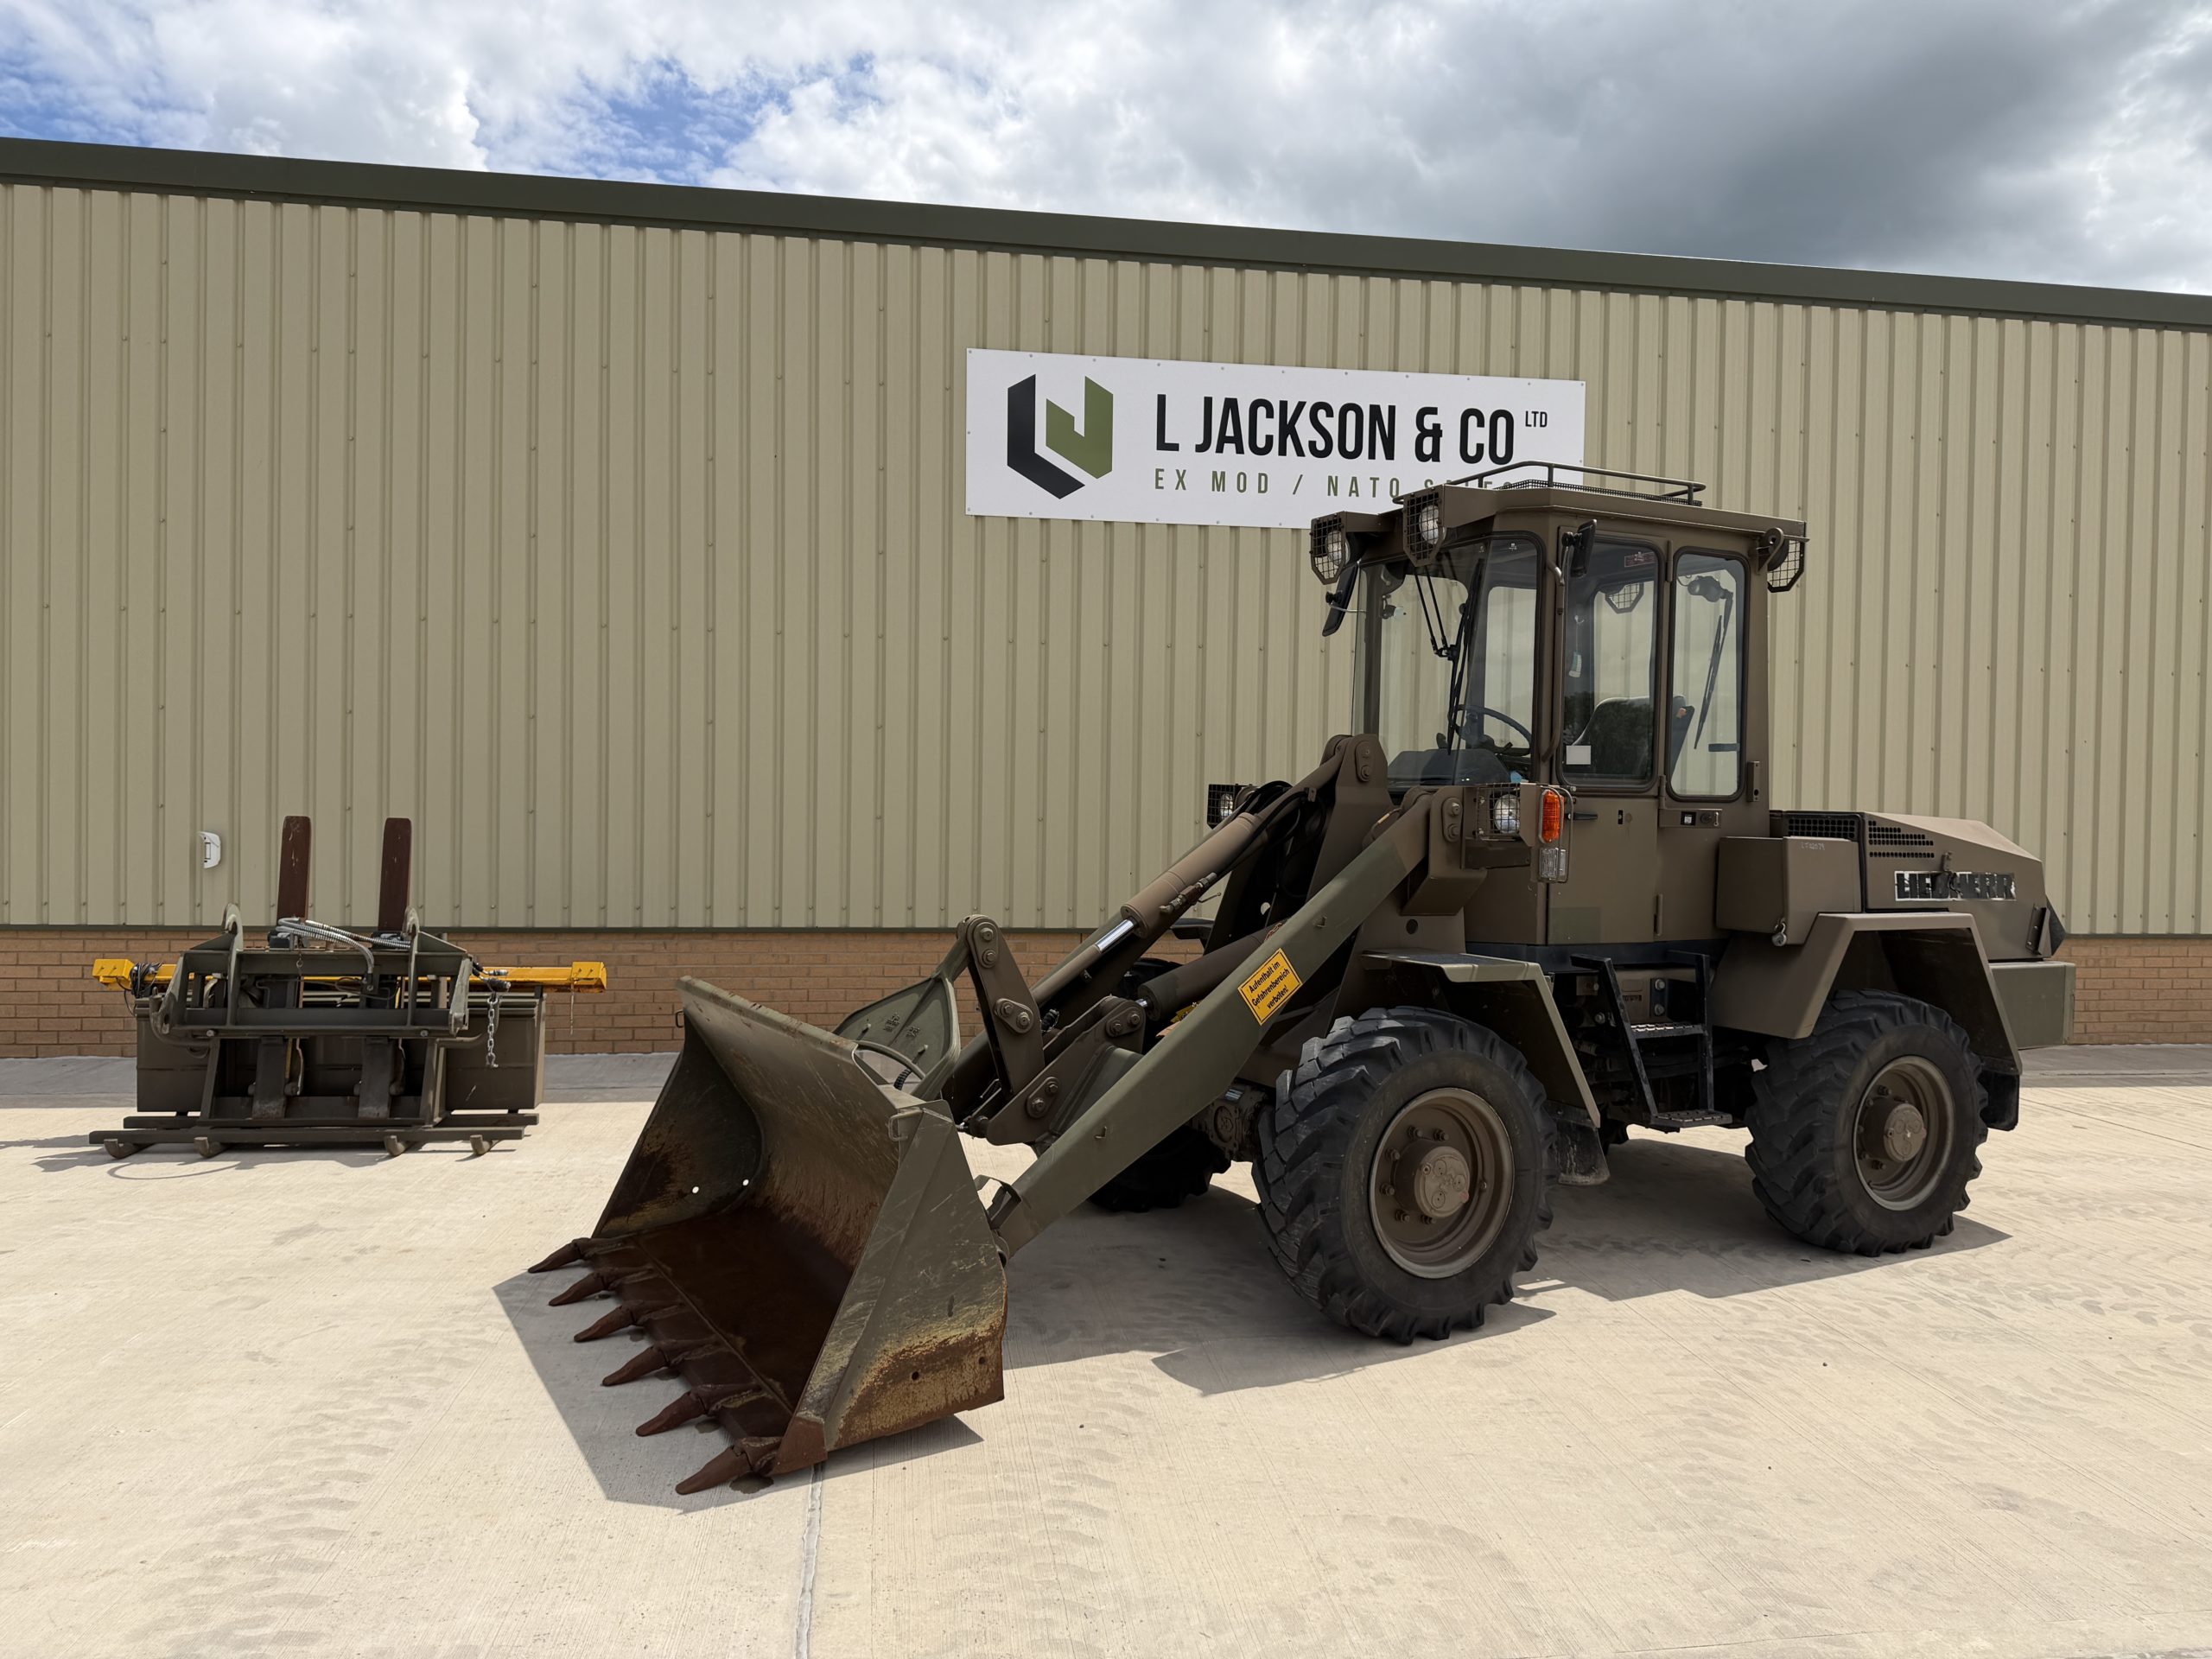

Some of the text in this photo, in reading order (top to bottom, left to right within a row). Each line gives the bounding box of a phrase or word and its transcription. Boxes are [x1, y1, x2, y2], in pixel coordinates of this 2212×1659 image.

[1156, 394, 1548, 466] L JACKSON & CO LTD
[1155, 468, 1187, 491] EX
[1211, 471, 1269, 494] MOD
[1293, 474, 1304, 496] /
[1327, 475, 1400, 499] NATO
[1249, 961, 1281, 993] Aufenthalt im
[1251, 968, 1290, 1007] Gefahrenbereich
[1267, 985, 1289, 1009] verboten!
